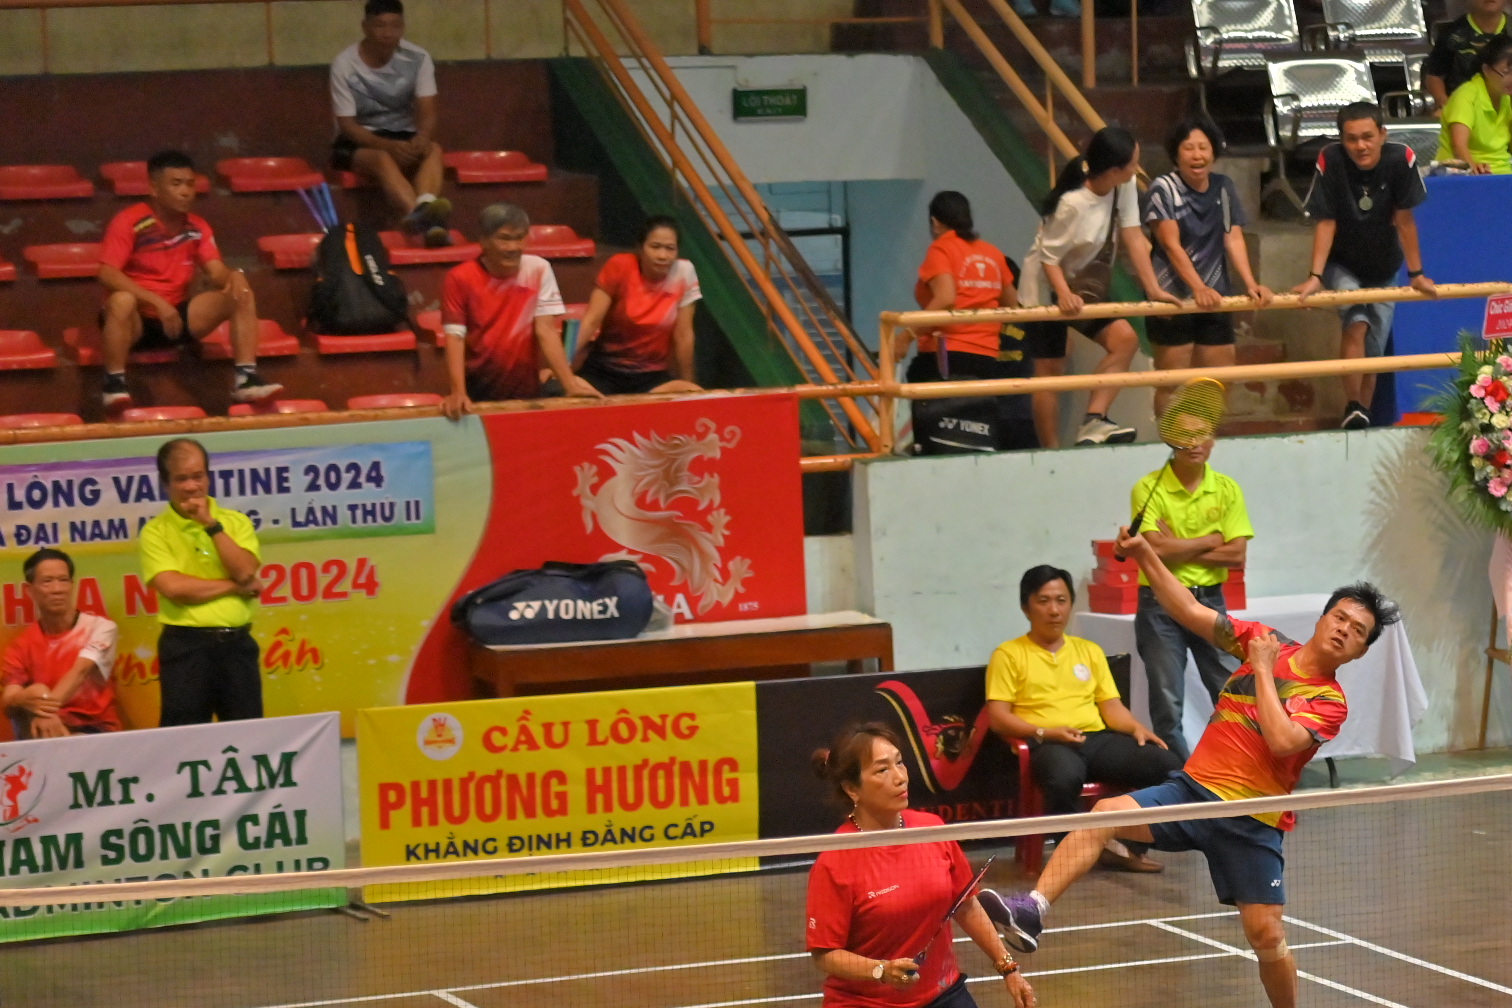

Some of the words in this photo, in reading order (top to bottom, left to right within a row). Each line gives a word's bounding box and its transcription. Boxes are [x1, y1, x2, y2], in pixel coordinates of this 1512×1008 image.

[959, 420, 990, 436] YONEX
[7, 475, 100, 511] LÔNG
[112, 466, 290, 504] VALTINE
[303, 461, 384, 493] 2024
[14, 522, 59, 550] ĐẠI
[69, 518, 128, 543] NAM
[291, 499, 338, 528] LẦN
[347, 497, 397, 525] THỨ
[405, 500, 421, 521] II
[3, 577, 112, 625] HA
[260, 557, 380, 606] 2024
[544, 597, 619, 620] YONEX
[482, 708, 572, 753] CẦU
[585, 707, 700, 747] LÔNG
[69, 768, 155, 810] Mr.
[176, 745, 298, 798] TÂM
[378, 769, 568, 830] PHƯƠNG
[585, 756, 740, 815] HƯƠNG
[100, 818, 220, 866] SÔNG
[237, 803, 309, 850] CÁI
[405, 831, 497, 861] KHẲNG
[506, 831, 572, 856] ĐỊNH
[581, 819, 655, 847] ĐẲNG
[663, 814, 715, 841] CẤP
